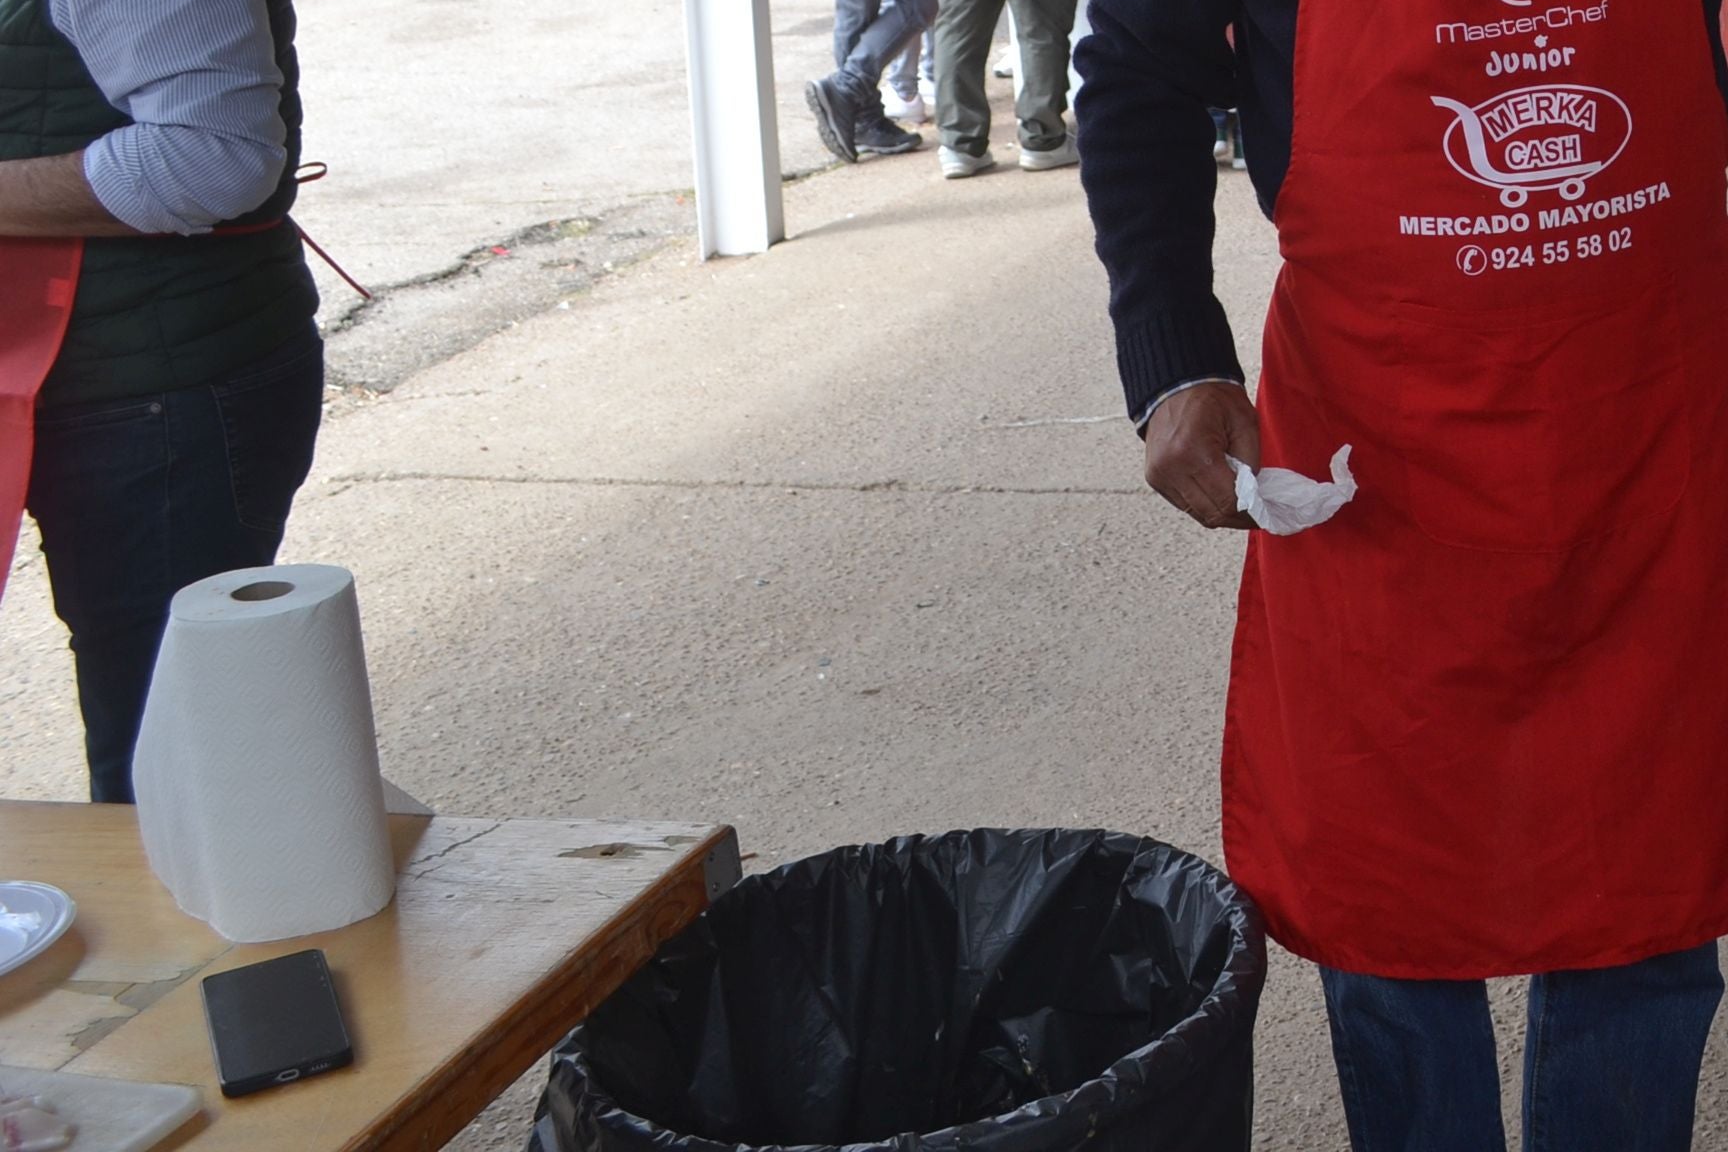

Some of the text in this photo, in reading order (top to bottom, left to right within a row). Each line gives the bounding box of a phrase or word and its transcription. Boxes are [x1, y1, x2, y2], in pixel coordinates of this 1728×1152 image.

[1435, 0, 1610, 44] MasterChef
[1485, 35, 1576, 77] Junior
[1480, 91, 1597, 143] MERKA
[1504, 133, 1583, 170] CASH
[1399, 182, 1671, 237] MERCADO MAYORISTA
[1491, 226, 1633, 271] 924 55 58 02
